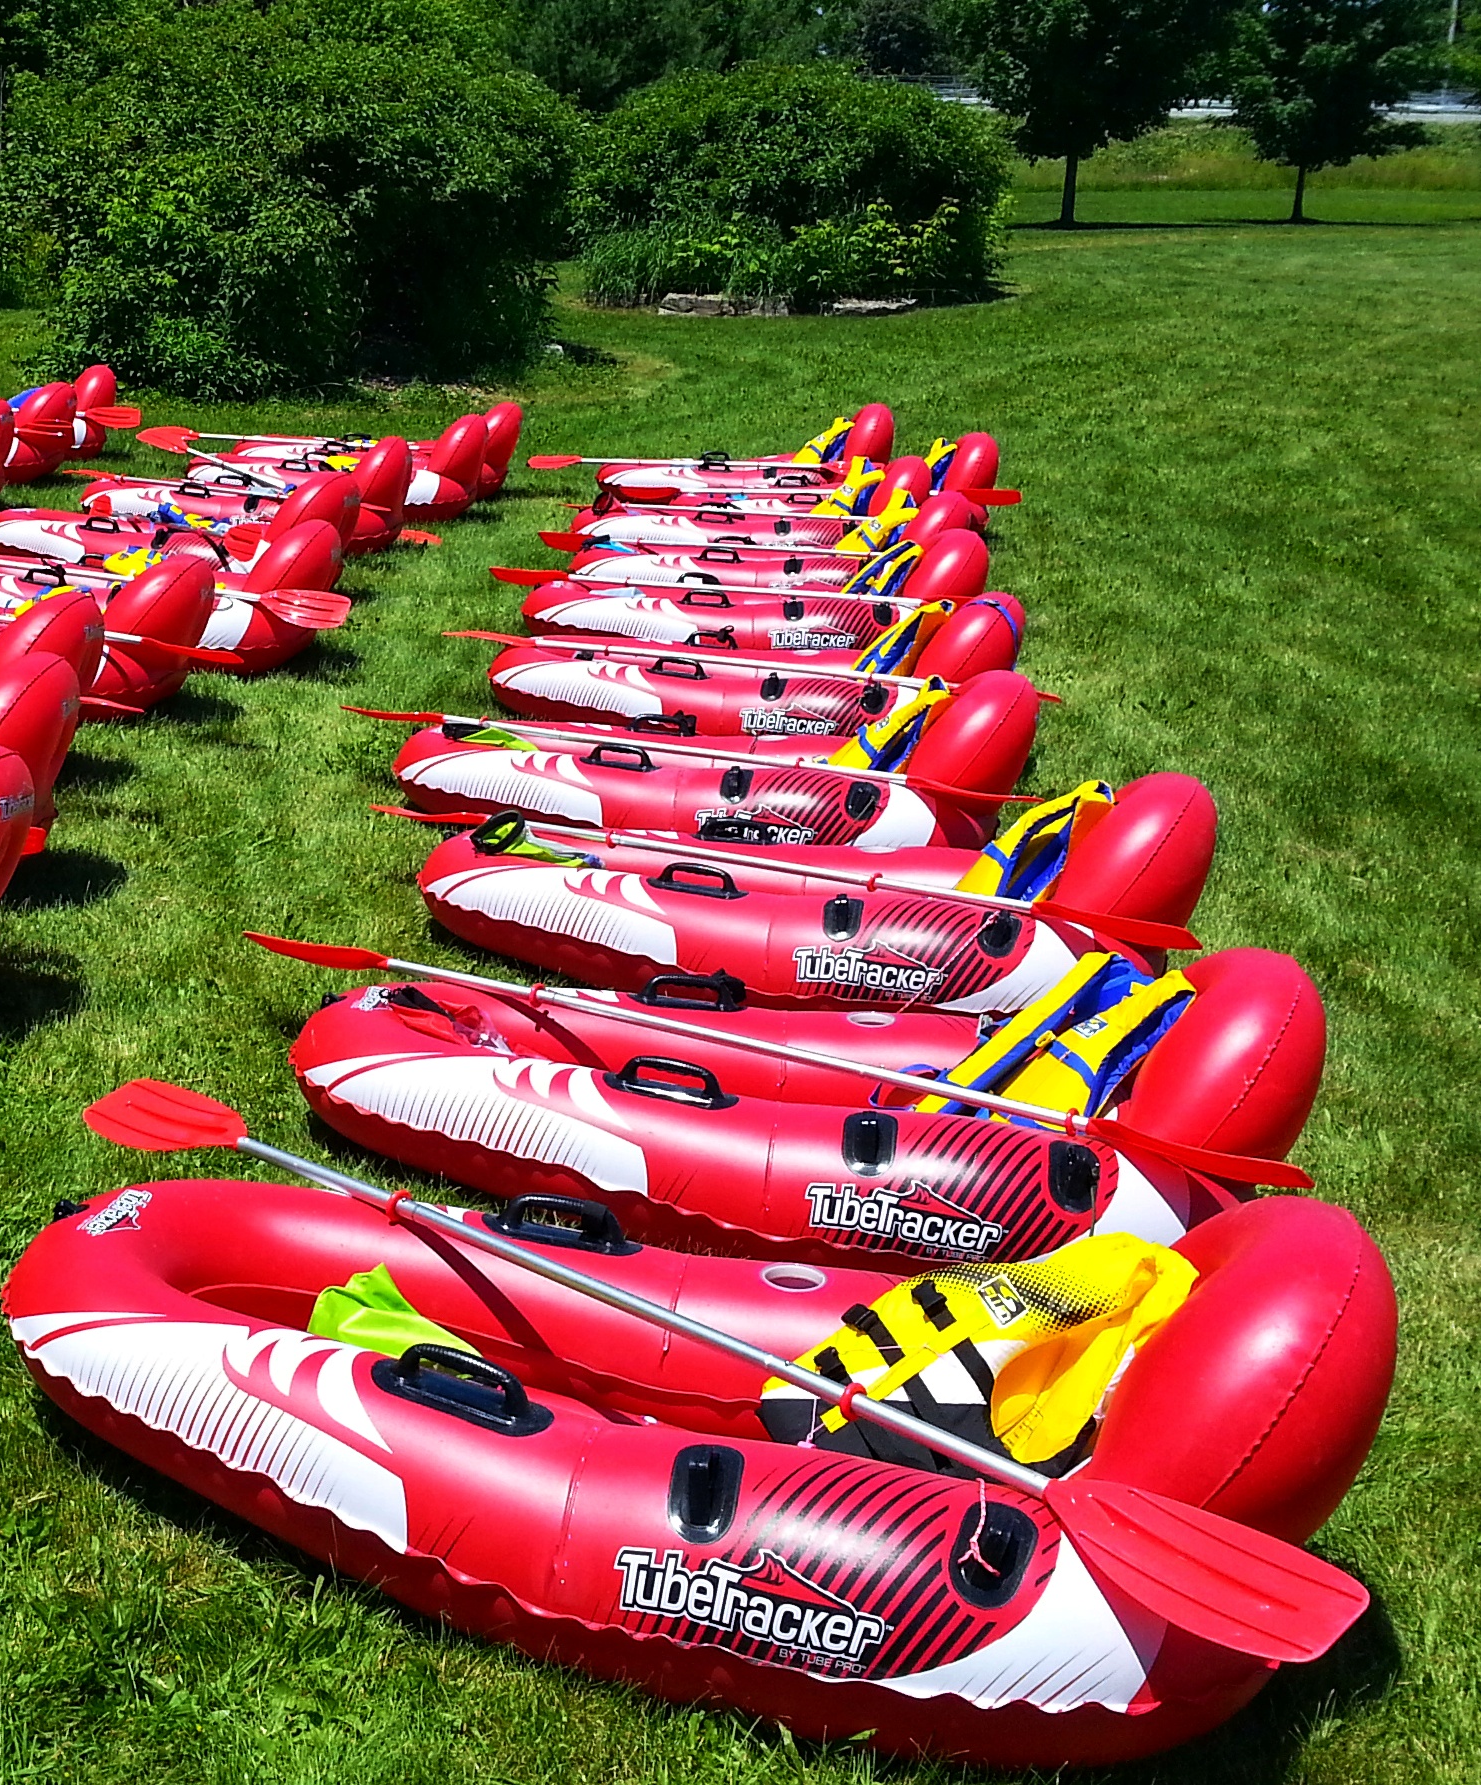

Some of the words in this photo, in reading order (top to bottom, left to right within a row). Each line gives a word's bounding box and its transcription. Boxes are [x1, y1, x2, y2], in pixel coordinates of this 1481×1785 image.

[768, 627, 856, 650] TubeTracker
[739, 707, 839, 735] TubeTracker
[792, 945, 944, 994] TubeTracker
[805, 1182, 1003, 1255] TubeTracker
[926, 1246, 939, 1255] BY
[941, 1249, 965, 1260] TUBE
[614, 1546, 885, 1661] TubeTracker
[779, 1648, 797, 1660] BY
[801, 1652, 834, 1668] TUBE
[835, 1660, 863, 1674] PRO
